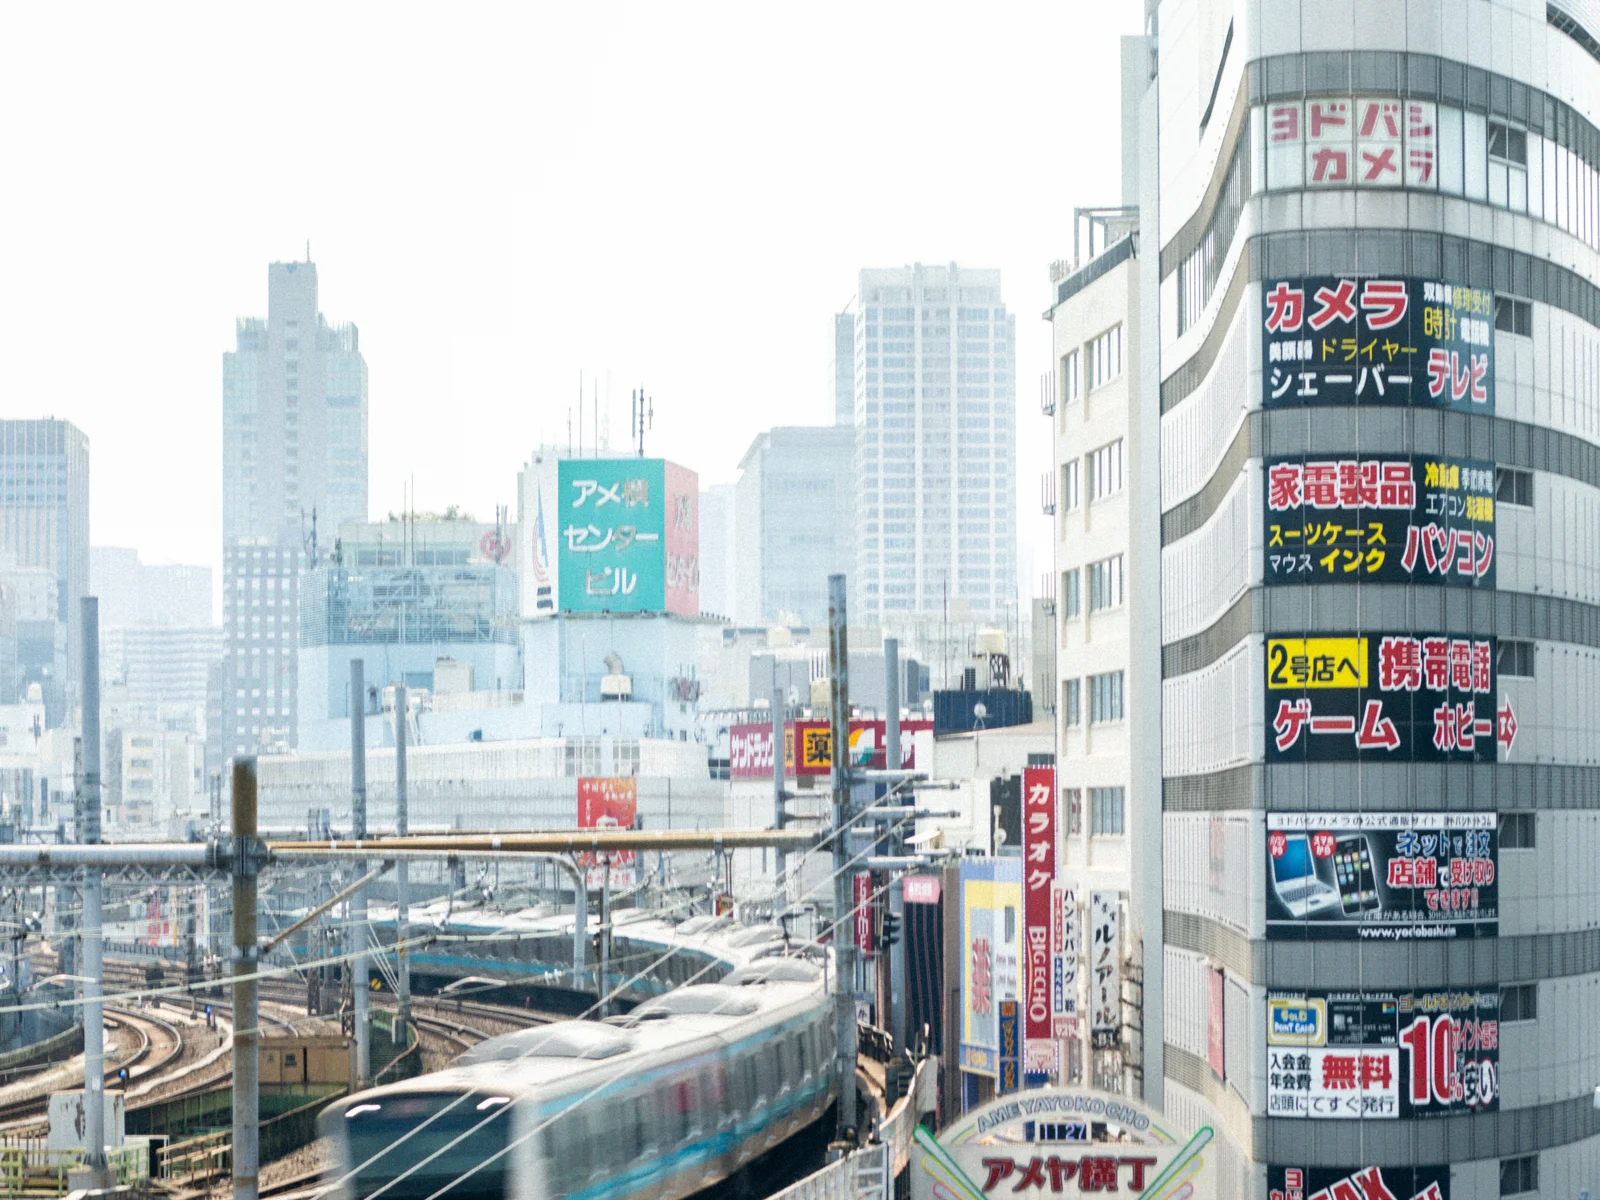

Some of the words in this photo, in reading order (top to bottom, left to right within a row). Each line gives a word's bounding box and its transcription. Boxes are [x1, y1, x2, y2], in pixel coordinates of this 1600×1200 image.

[1272, 103, 1432, 141] ヨドバシ
[1312, 148, 1432, 184] カメラ
[1266, 280, 1408, 333] カメラ
[1424, 306, 1457, 341] 時計
[1321, 338, 1418, 362] ドライヤー
[1270, 363, 1413, 399] シェーバー
[1428, 347, 1488, 403] テレビ
[572, 477, 648, 508] アメ横
[1268, 461, 1416, 510] 家電製品
[1425, 493, 1466, 518] エアコン
[564, 524, 659, 551] センター
[1269, 521, 1387, 547] スーツケース
[1401, 522, 1494, 579] パソコン
[1269, 553, 1313, 574] マウス
[1320, 548, 1386, 573] インク
[586, 567, 637, 594] ビル
[1270, 643, 1360, 685] 2号店へ
[1379, 636, 1491, 693] 携帯電話
[1273, 699, 1400, 752] ゲーム
[1433, 700, 1492, 751] ホビー
[1027, 782, 1050, 891] カラオケ
[1395, 830, 1490, 856] ネットで注文
[1386, 857, 1495, 888] 店舗で受け取り
[1028, 925, 1047, 965] BIG
[1094, 923, 1116, 1026] ルノアール
[1028, 966, 1047, 1023] ECHO
[1270, 1053, 1312, 1071] 入会金
[1322, 1053, 1393, 1090] 無料
[1270, 1073, 1312, 1091] 年会費
[1270, 1094, 1395, 1113] 店頭にてすぐ発行
[982, 1155, 1158, 1193] アメヤ横丁
